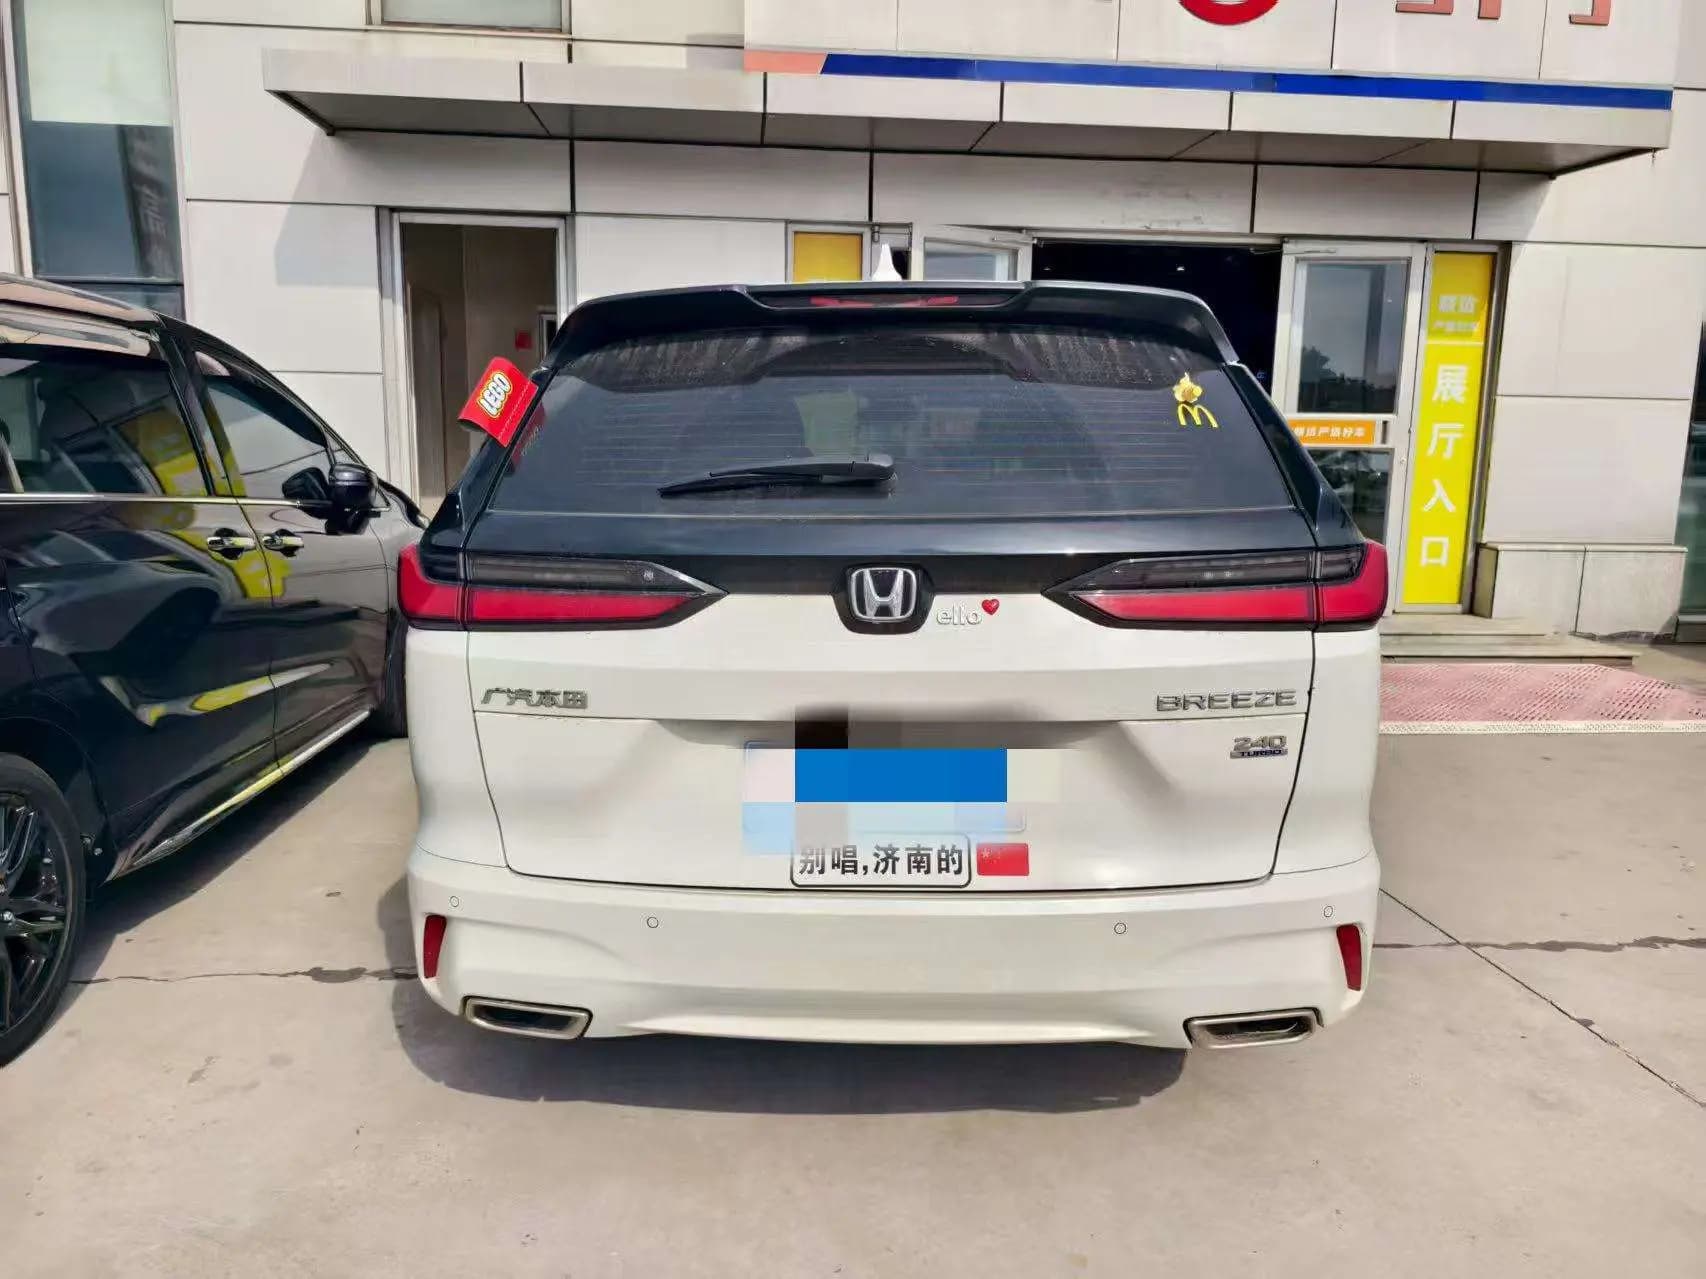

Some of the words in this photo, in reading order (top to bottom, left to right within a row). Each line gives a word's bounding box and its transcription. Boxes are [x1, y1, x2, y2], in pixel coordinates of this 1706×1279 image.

[479, 372, 512, 416] LEGO
[1419, 364, 1468, 568] 展厅入口
[936, 600, 983, 626] ello
[480, 687, 588, 709] 广汽本田
[1156, 688, 1297, 712] BREEZE
[1233, 735, 1287, 752] 240
[1239, 748, 1284, 758] TURBO
[798, 843, 963, 876] 别唱,济南的
